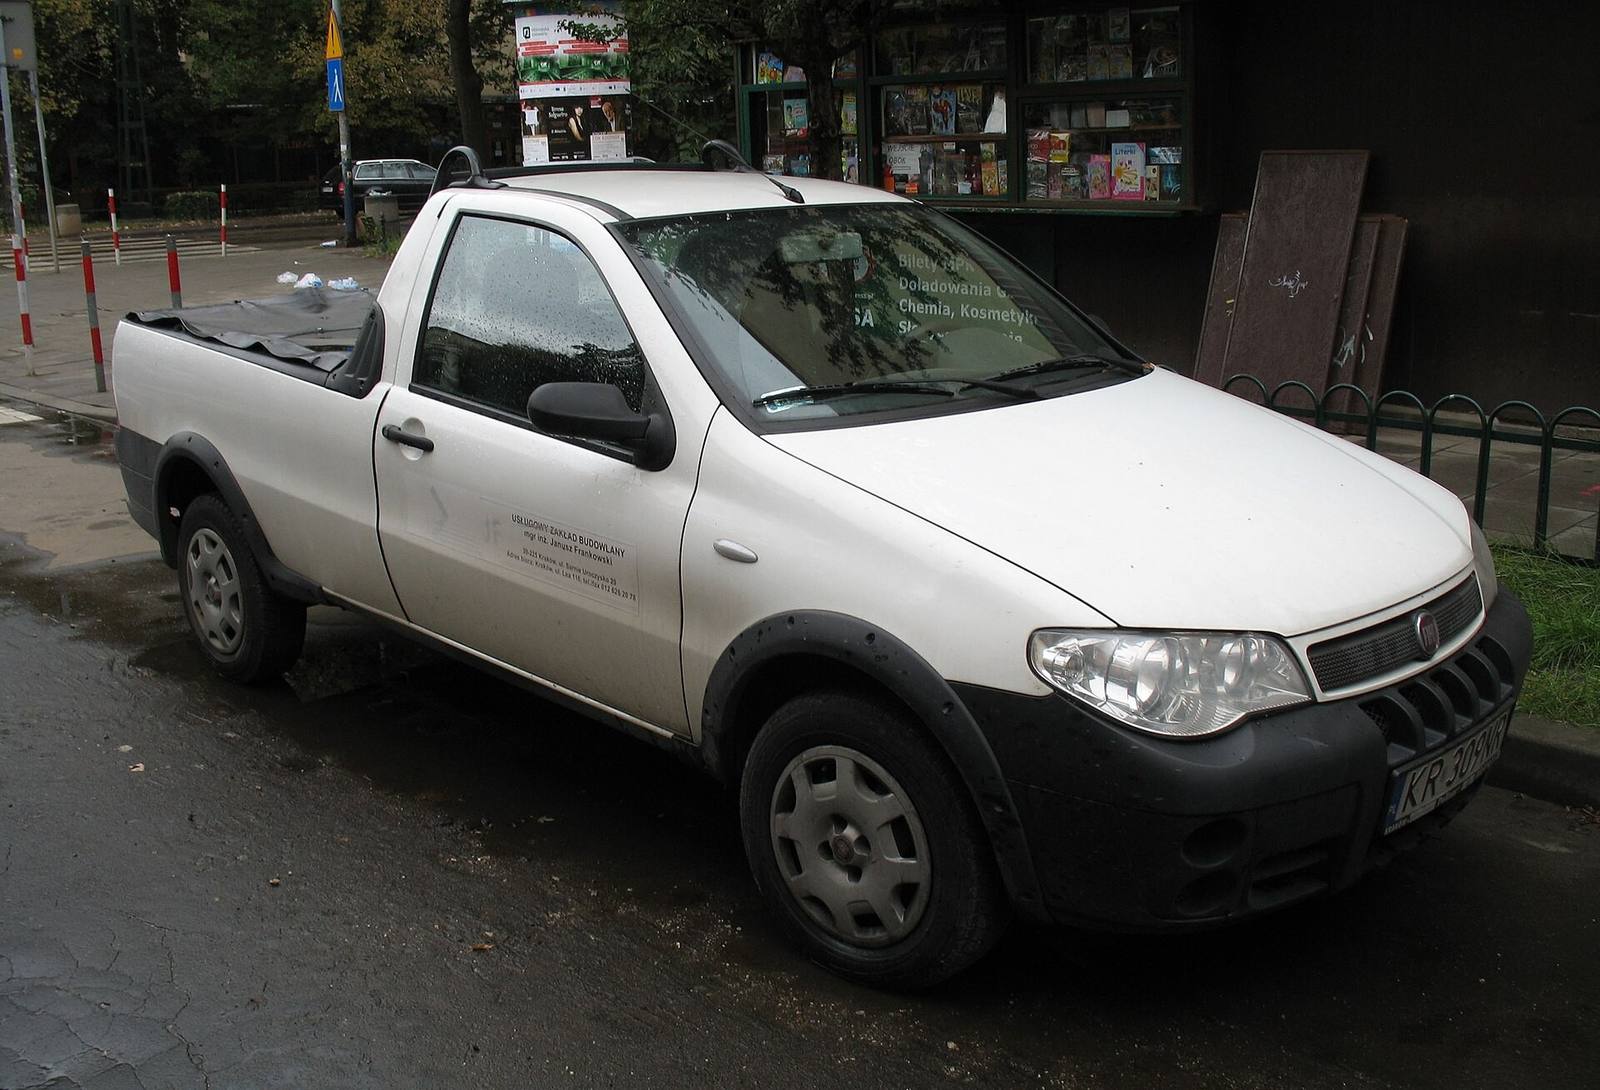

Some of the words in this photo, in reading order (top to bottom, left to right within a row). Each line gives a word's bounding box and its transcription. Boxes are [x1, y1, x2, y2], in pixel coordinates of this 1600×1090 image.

[899, 299, 955, 319] Chemia,
[511, 514, 548, 532] USŁUGOWY
[550, 526, 577, 542] ZAKŁAD
[579, 535, 625, 558] BUDOWLANY
[550, 538, 573, 553] Janusz
[574, 545, 614, 566] Frankowski
[1402, 757, 1444, 813] KR
